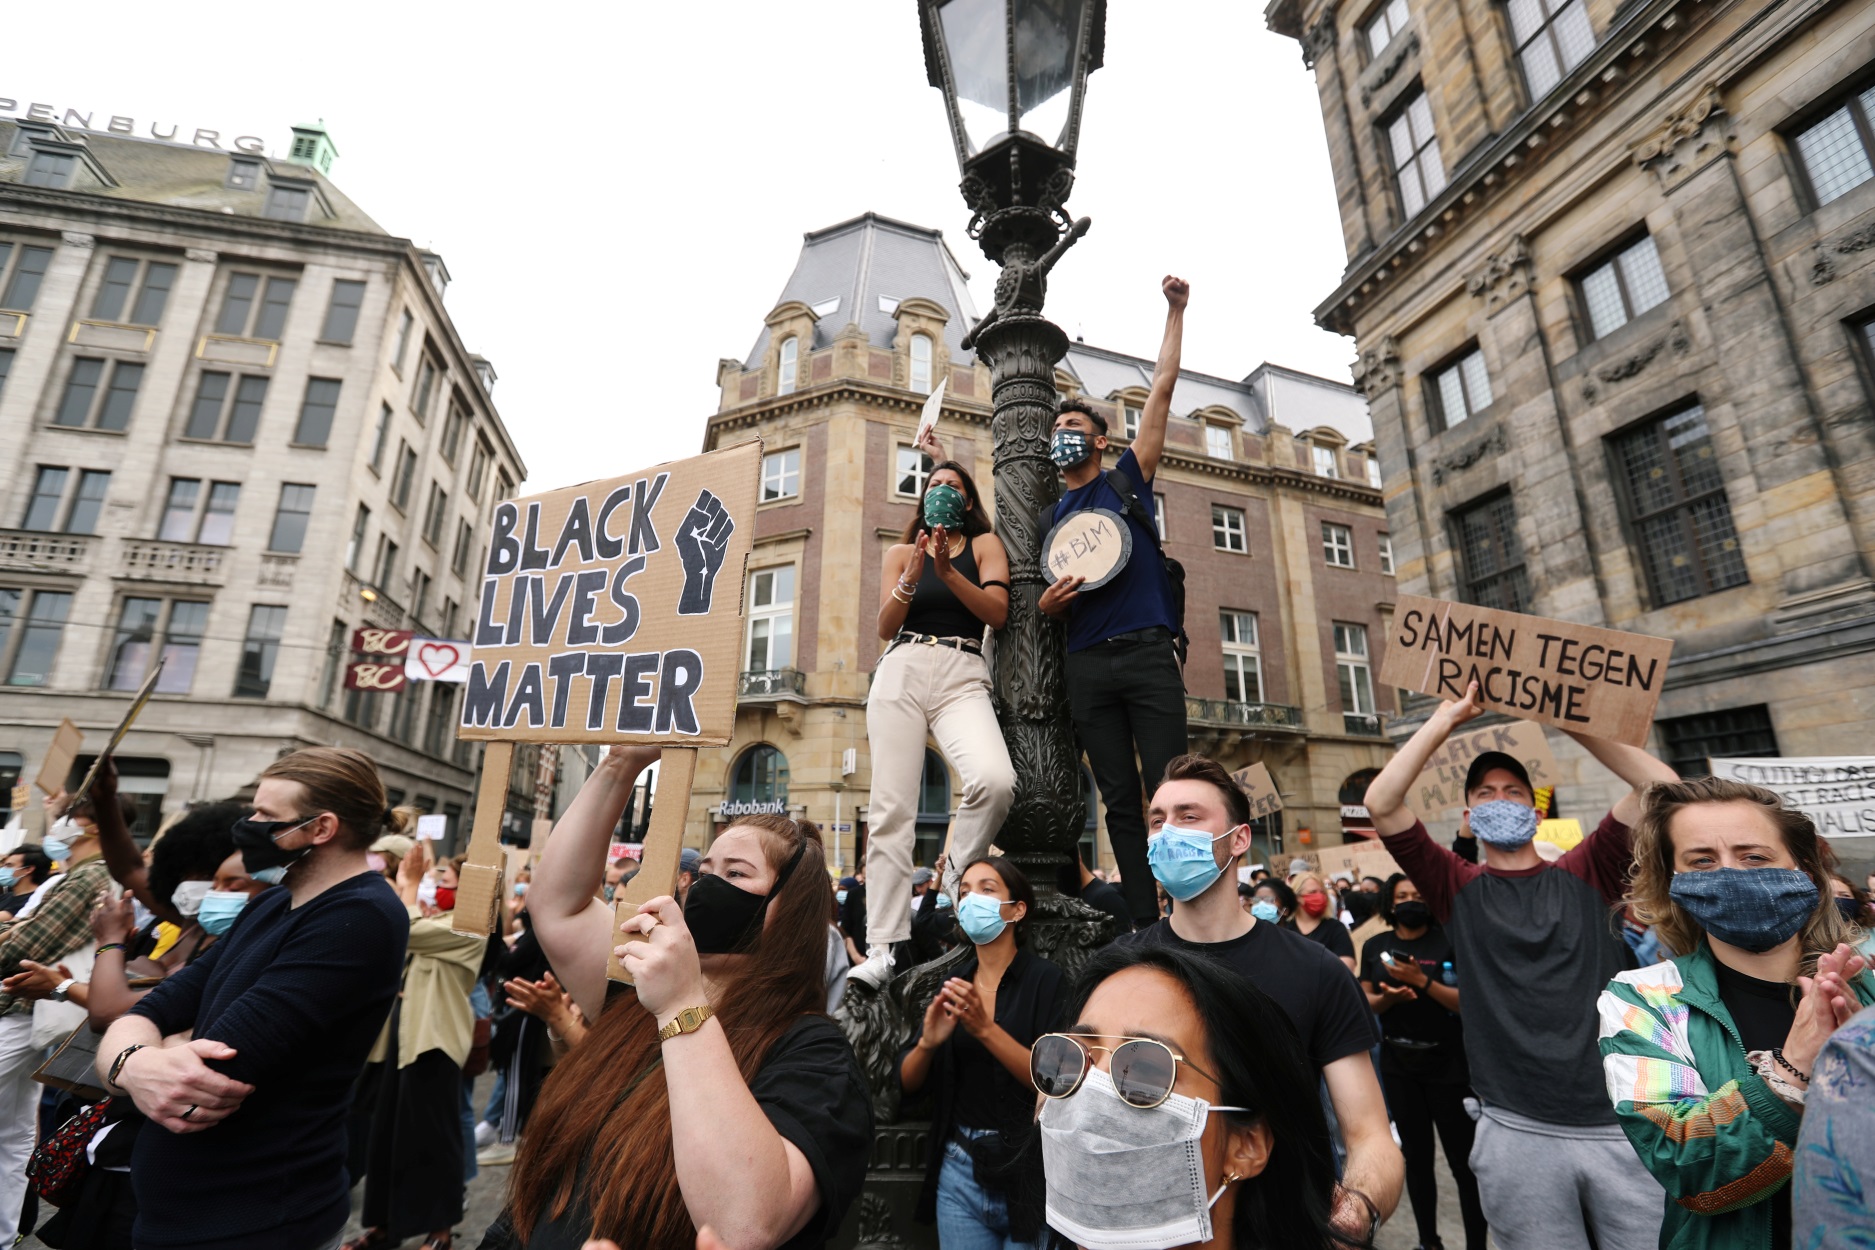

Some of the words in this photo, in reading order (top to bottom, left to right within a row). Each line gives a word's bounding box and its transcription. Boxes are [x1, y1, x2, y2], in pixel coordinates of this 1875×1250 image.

[485, 472, 671, 576] BLACK
[473, 556, 646, 648] LIVES
[461, 649, 704, 735] MATTER
[1399, 610, 1516, 662] SAMEN
[1537, 634, 1658, 691] TEGEN
[1437, 659, 1590, 723] RACISME
[719, 798, 785, 816] Rabobank
